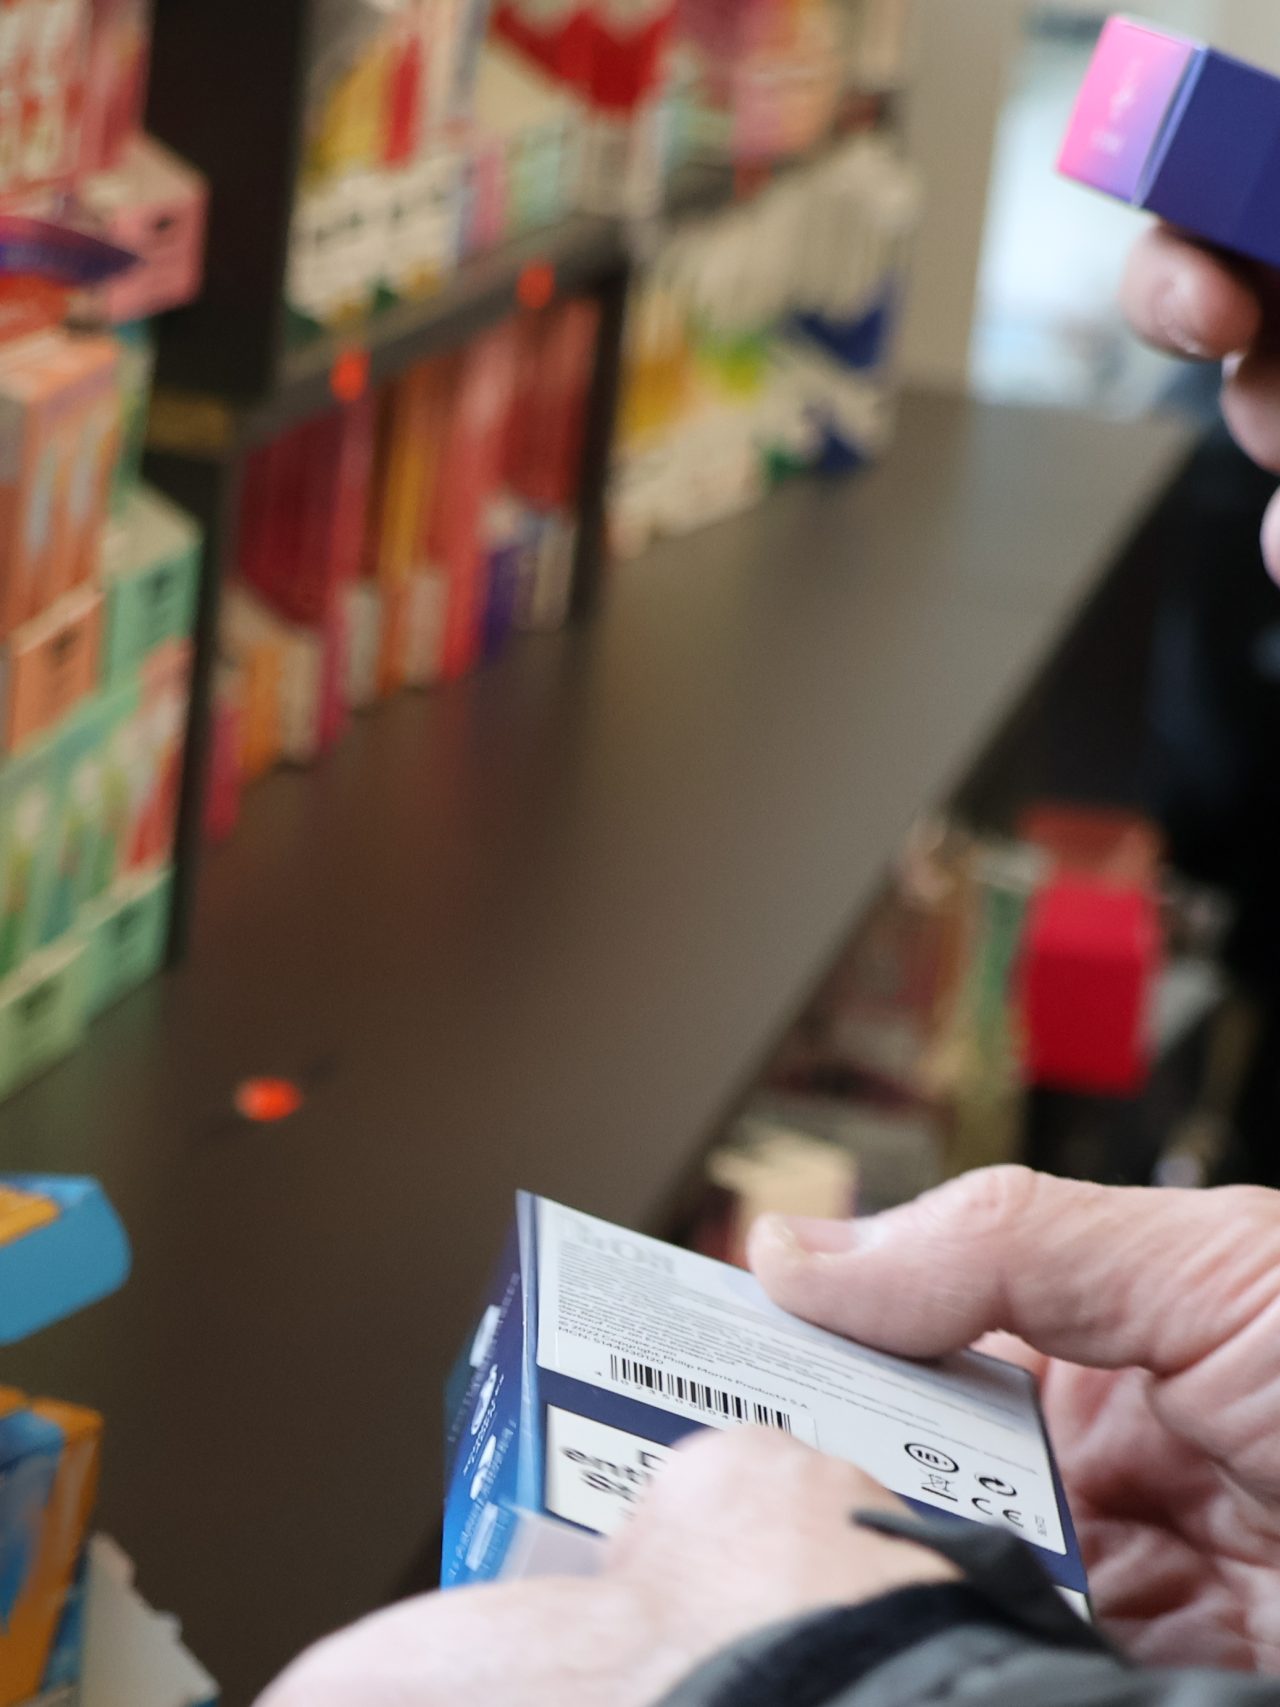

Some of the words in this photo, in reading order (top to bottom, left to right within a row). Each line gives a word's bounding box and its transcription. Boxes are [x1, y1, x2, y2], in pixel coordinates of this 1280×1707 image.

[696, 1365, 732, 1383] Morris
[735, 1378, 787, 1402] Products
[914, 1449, 948, 1466] 18+
